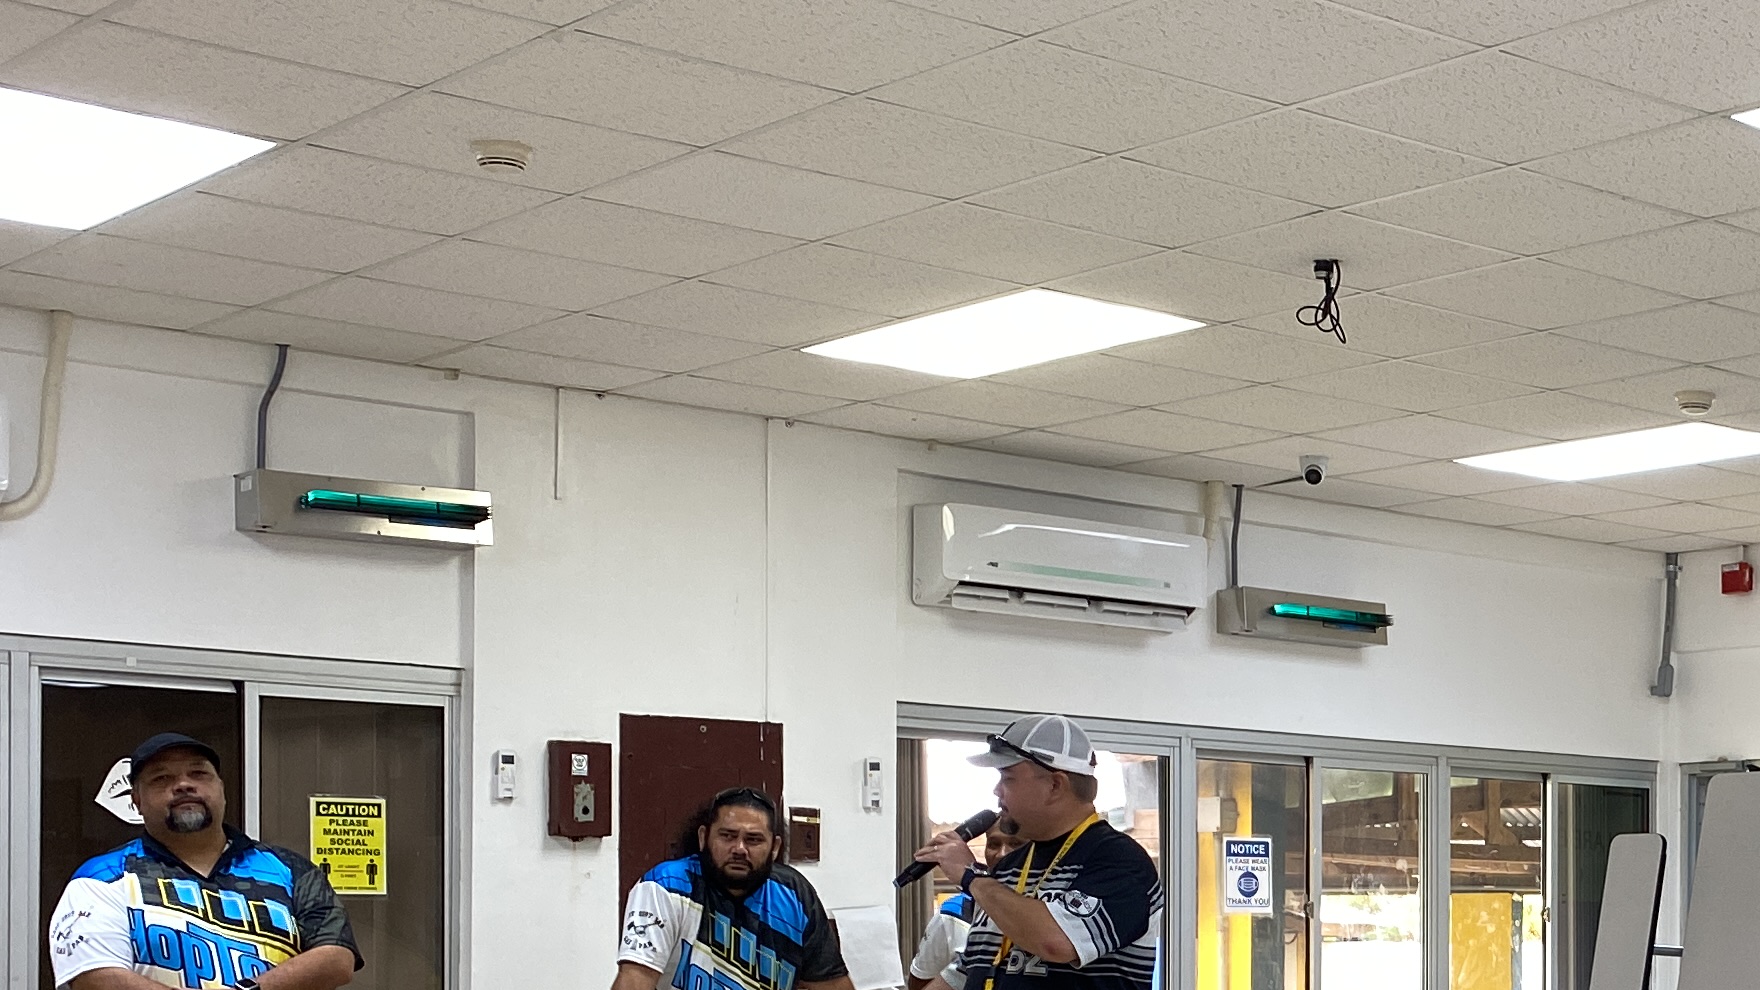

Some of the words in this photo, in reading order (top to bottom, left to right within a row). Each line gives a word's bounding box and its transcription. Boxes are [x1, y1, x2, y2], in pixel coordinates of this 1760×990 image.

[319, 804, 378, 816] CAUTION
[329, 818, 369, 828] PLEASE
[323, 828, 375, 837] MAINTAIN
[329, 838, 368, 846] SOCIAL
[316, 847, 381, 856] DISTANCING
[1230, 843, 1266, 855] NOTICE
[1254, 898, 1269, 906] YOU
